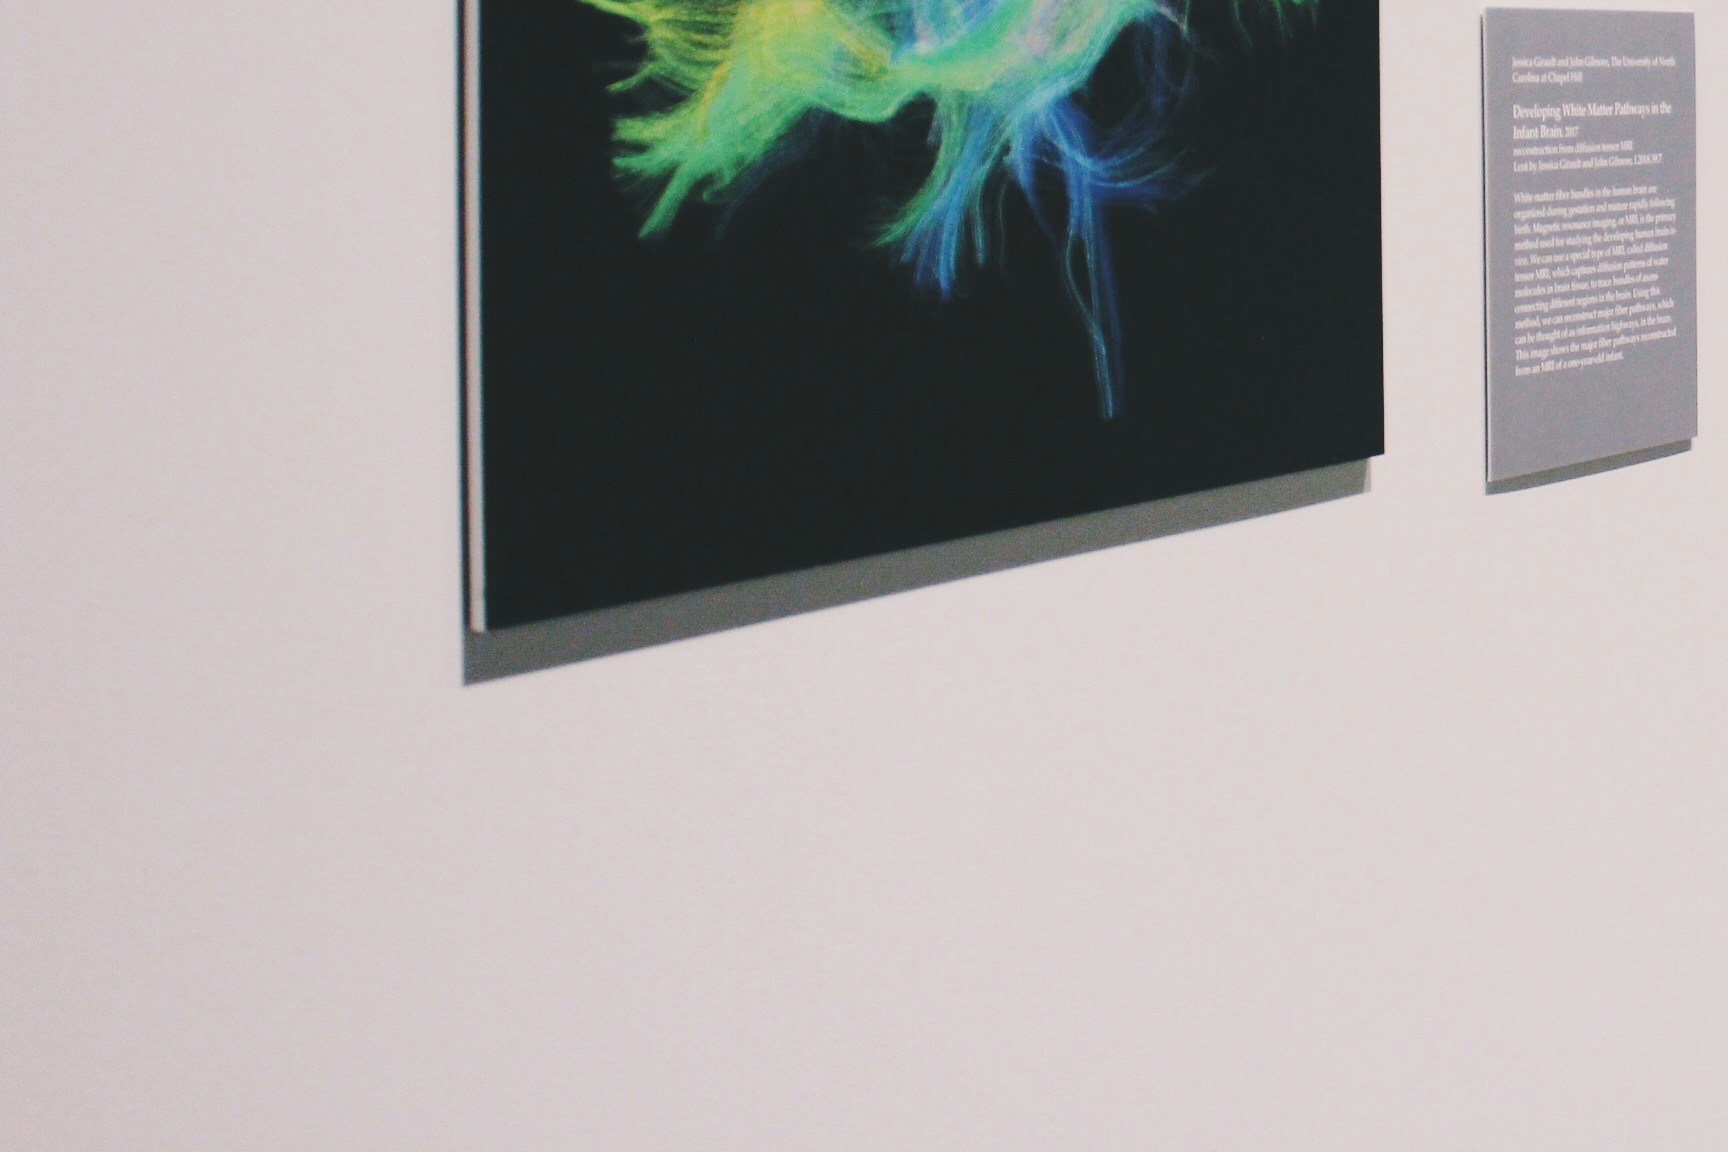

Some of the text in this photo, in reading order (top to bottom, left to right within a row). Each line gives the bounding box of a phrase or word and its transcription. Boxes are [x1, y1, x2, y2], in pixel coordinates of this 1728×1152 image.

[1611, 56, 1621, 67] The
[1513, 101, 1672, 121] Developing White Matter Pathways in the
[1513, 125, 1539, 139] Infant
